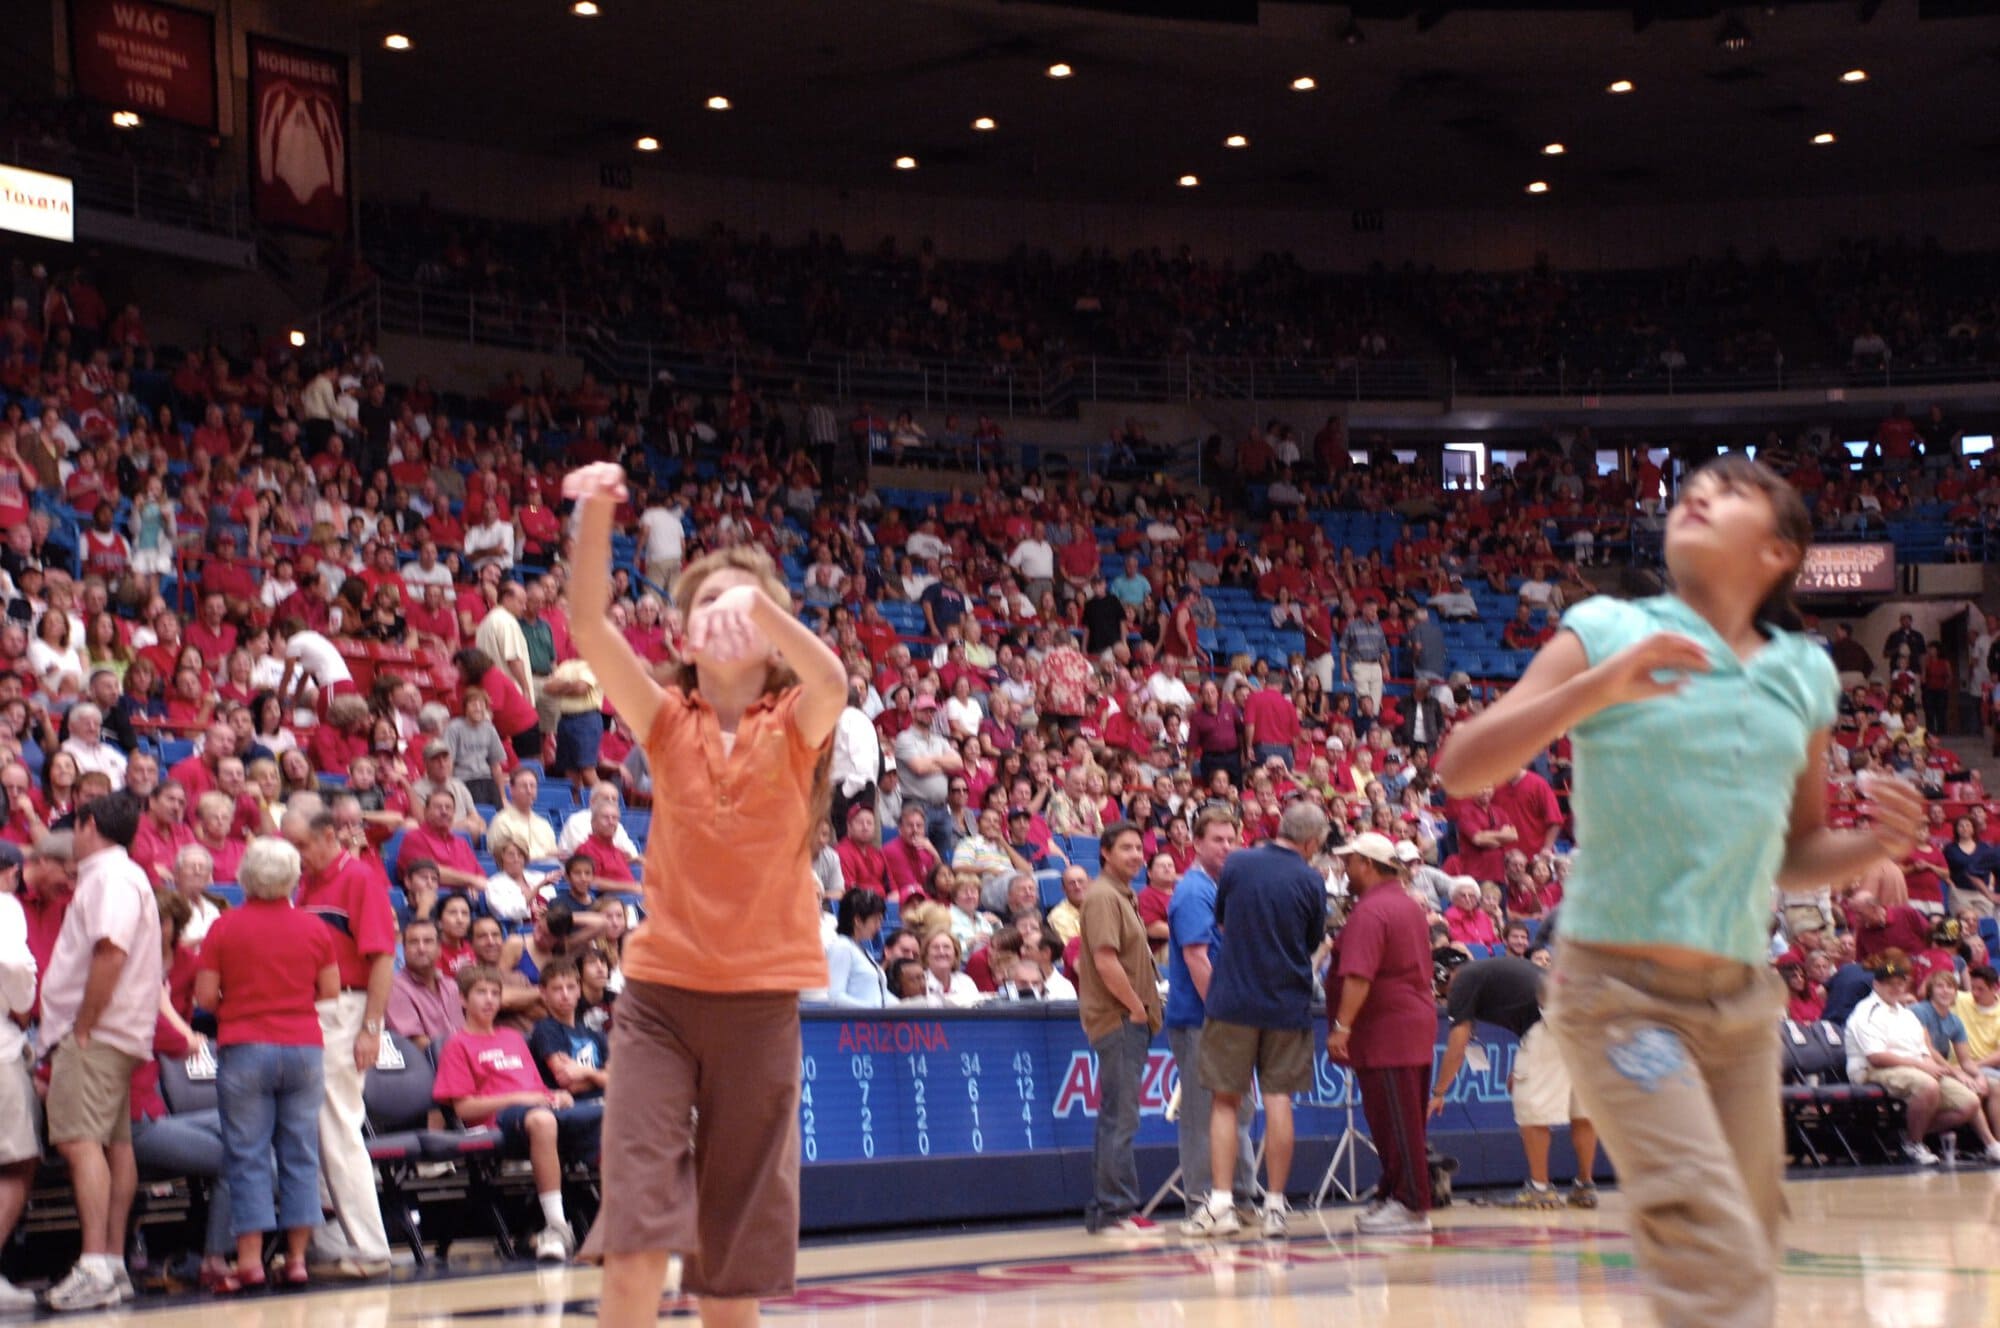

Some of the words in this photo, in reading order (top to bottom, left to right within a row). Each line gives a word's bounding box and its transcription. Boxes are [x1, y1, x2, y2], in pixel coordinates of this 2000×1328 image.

[112, 4, 168, 39] WAC
[838, 1022, 950, 1052] ARIZONA
[851, 1054, 874, 1080] 05
[907, 1052, 928, 1078] 14
[960, 1052, 981, 1077] 34
[1013, 1051, 1032, 1075] 43
[802, 1081, 813, 1107] 4
[859, 1080, 869, 1104] 7
[914, 1078, 926, 1104] 2
[968, 1077, 979, 1102] 6
[1016, 1076, 1035, 1100] 12
[804, 1108, 815, 1134] 2
[861, 1106, 872, 1131] 2
[916, 1104, 928, 1130] 2
[971, 1103, 979, 1127] 1
[1022, 1101, 1032, 1125] 4
[805, 1135, 817, 1162] 0
[863, 1132, 874, 1159] 0
[918, 1130, 930, 1156] 0
[972, 1128, 983, 1153] 0
[1025, 1126, 1032, 1151] 1
